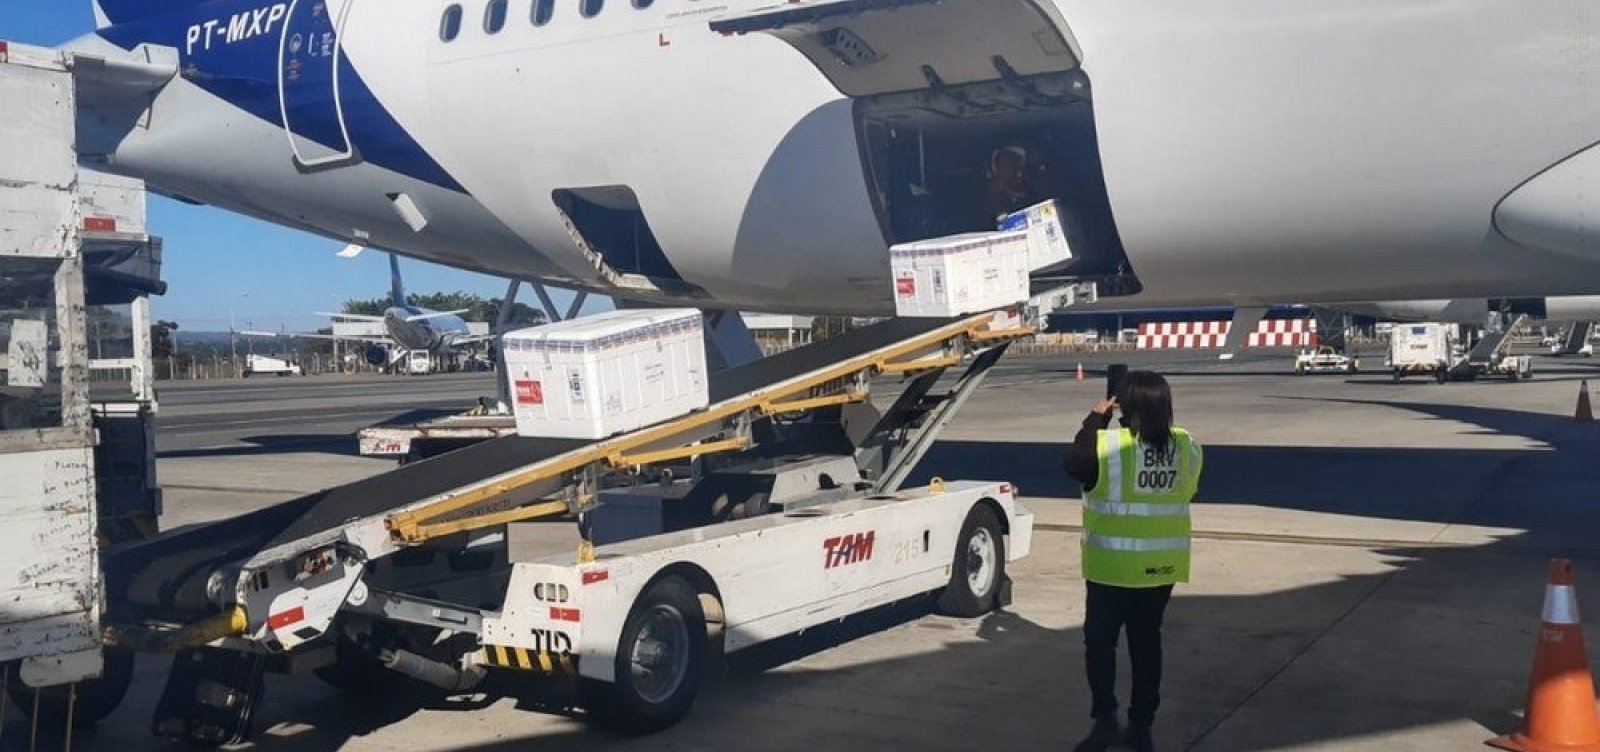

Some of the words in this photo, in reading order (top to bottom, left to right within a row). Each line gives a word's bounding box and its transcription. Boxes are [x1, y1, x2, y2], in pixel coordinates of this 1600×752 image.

[186, 4, 286, 56] PT-MXP
[1143, 448, 1176, 467] BRV
[1138, 471, 1177, 488] 0007
[823, 529, 875, 569] TAM
